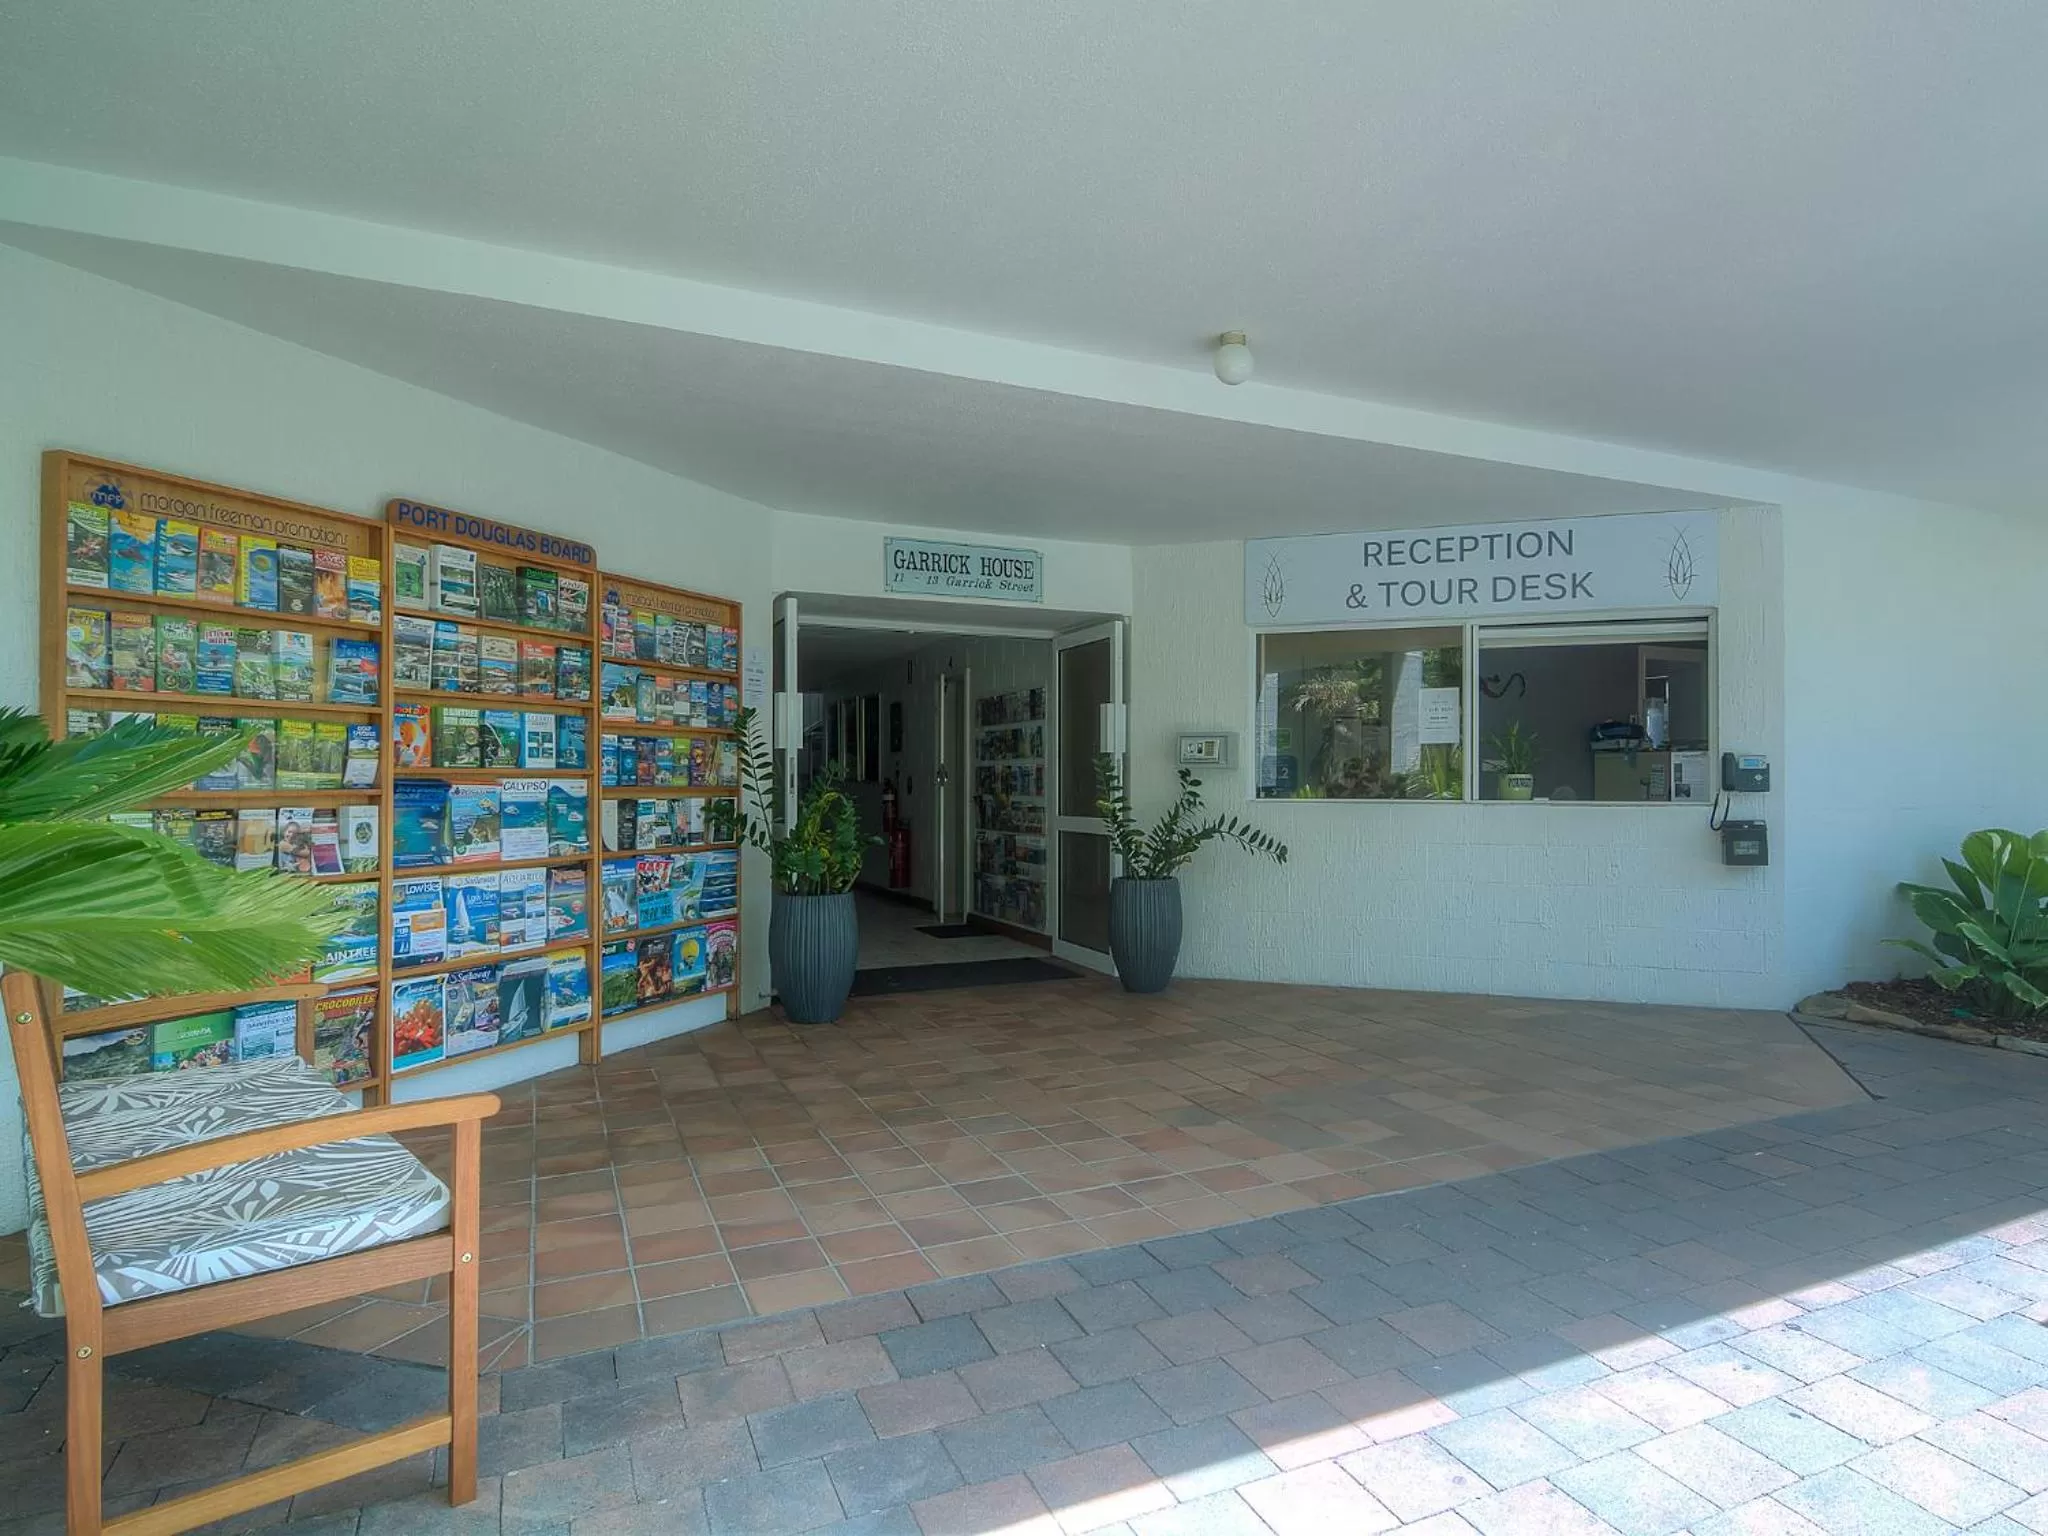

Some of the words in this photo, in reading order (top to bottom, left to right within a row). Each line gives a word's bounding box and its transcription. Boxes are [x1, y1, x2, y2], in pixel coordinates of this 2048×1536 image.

[140, 492, 206, 520] morgan
[209, 502, 273, 530] freeman
[398, 502, 450, 531] PORT
[455, 516, 536, 551] DOUGLAS
[540, 536, 592, 564] BOARD
[1363, 529, 1574, 568] RECEPTION
[893, 549, 972, 575] GARRICK
[980, 556, 1035, 580] HOUSE
[893, 572, 905, 583] 11
[926, 575, 940, 586] 13
[946, 575, 994, 590] Garrick
[998, 579, 1035, 593] Street
[1345, 582, 1369, 610] &
[1377, 577, 1480, 609] TOUR
[1491, 571, 1595, 604] DESK
[503, 780, 547, 792] CALYPSO
[324, 945, 378, 965] AINTREE
[314, 994, 377, 1011] CROCODILES
